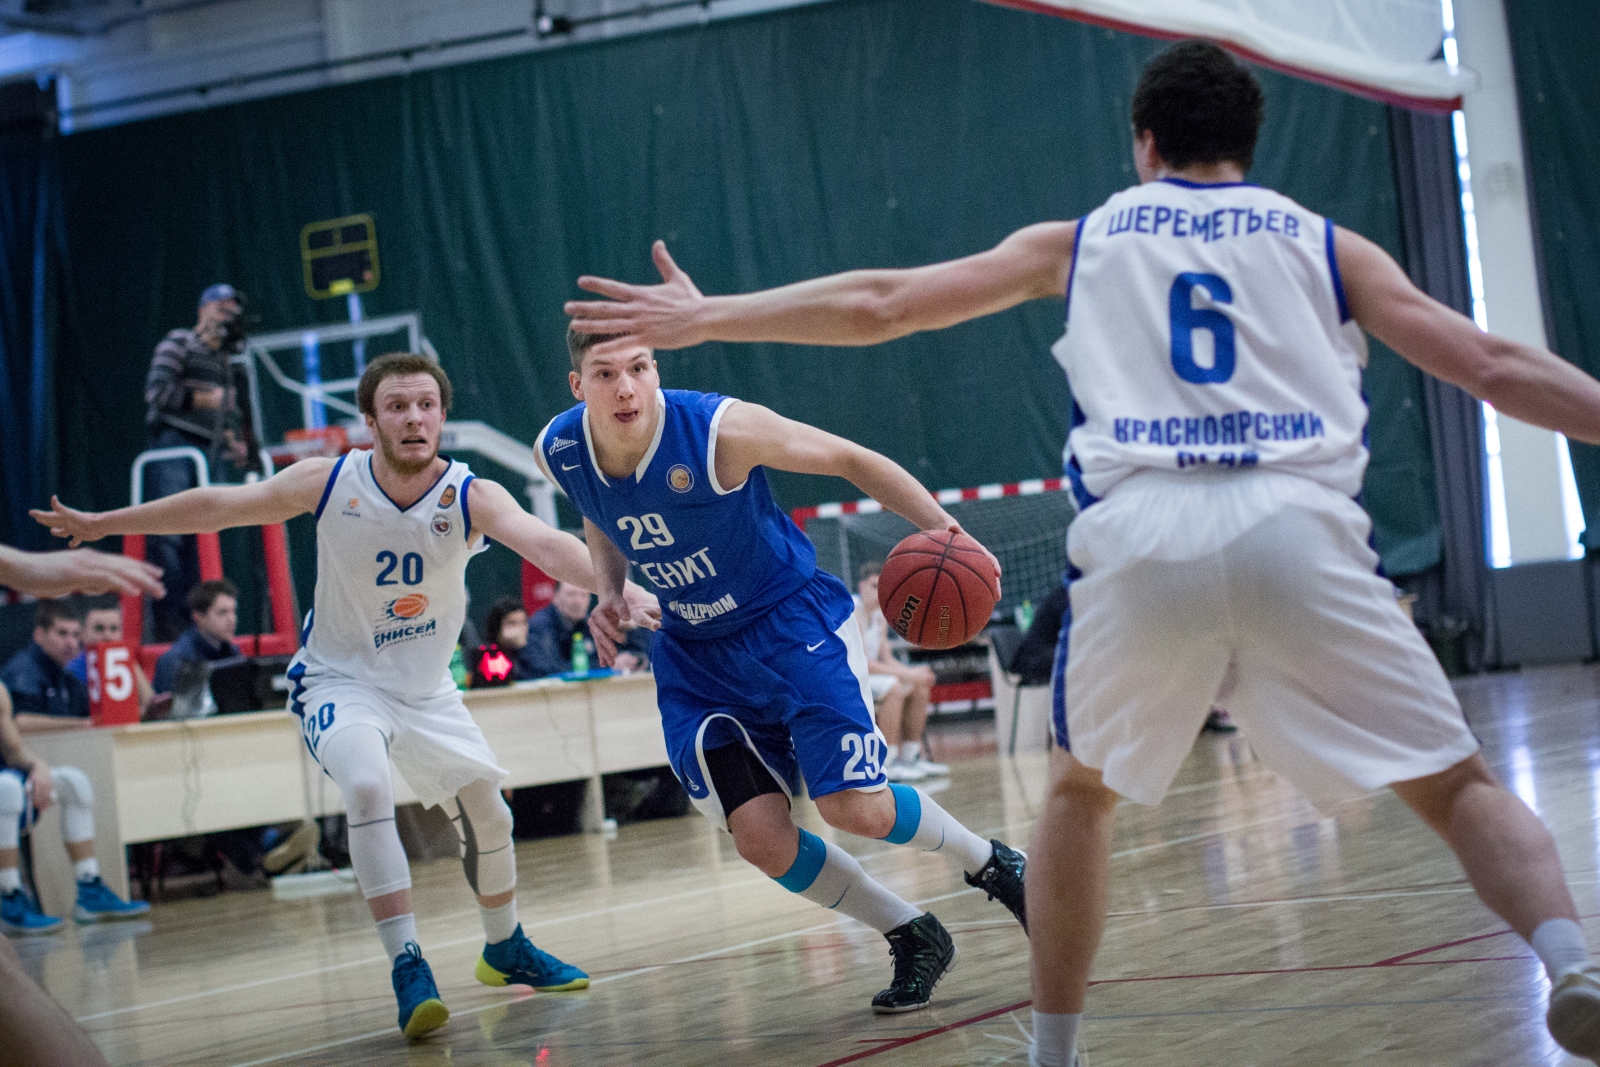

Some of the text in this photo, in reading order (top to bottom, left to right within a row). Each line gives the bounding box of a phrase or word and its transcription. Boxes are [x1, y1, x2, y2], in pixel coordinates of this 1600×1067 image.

[1106, 205, 1300, 243] ШЕРЕМЕТЬЕВ
[1169, 271, 1236, 385] 6
[616, 512, 675, 551] 29
[375, 550, 424, 587] 20
[630, 546, 718, 589] ЕНИТ
[678, 593, 738, 619] GAZPROM
[104, 647, 134, 702] 5
[307, 702, 336, 752] 20
[841, 732, 881, 781] 29
